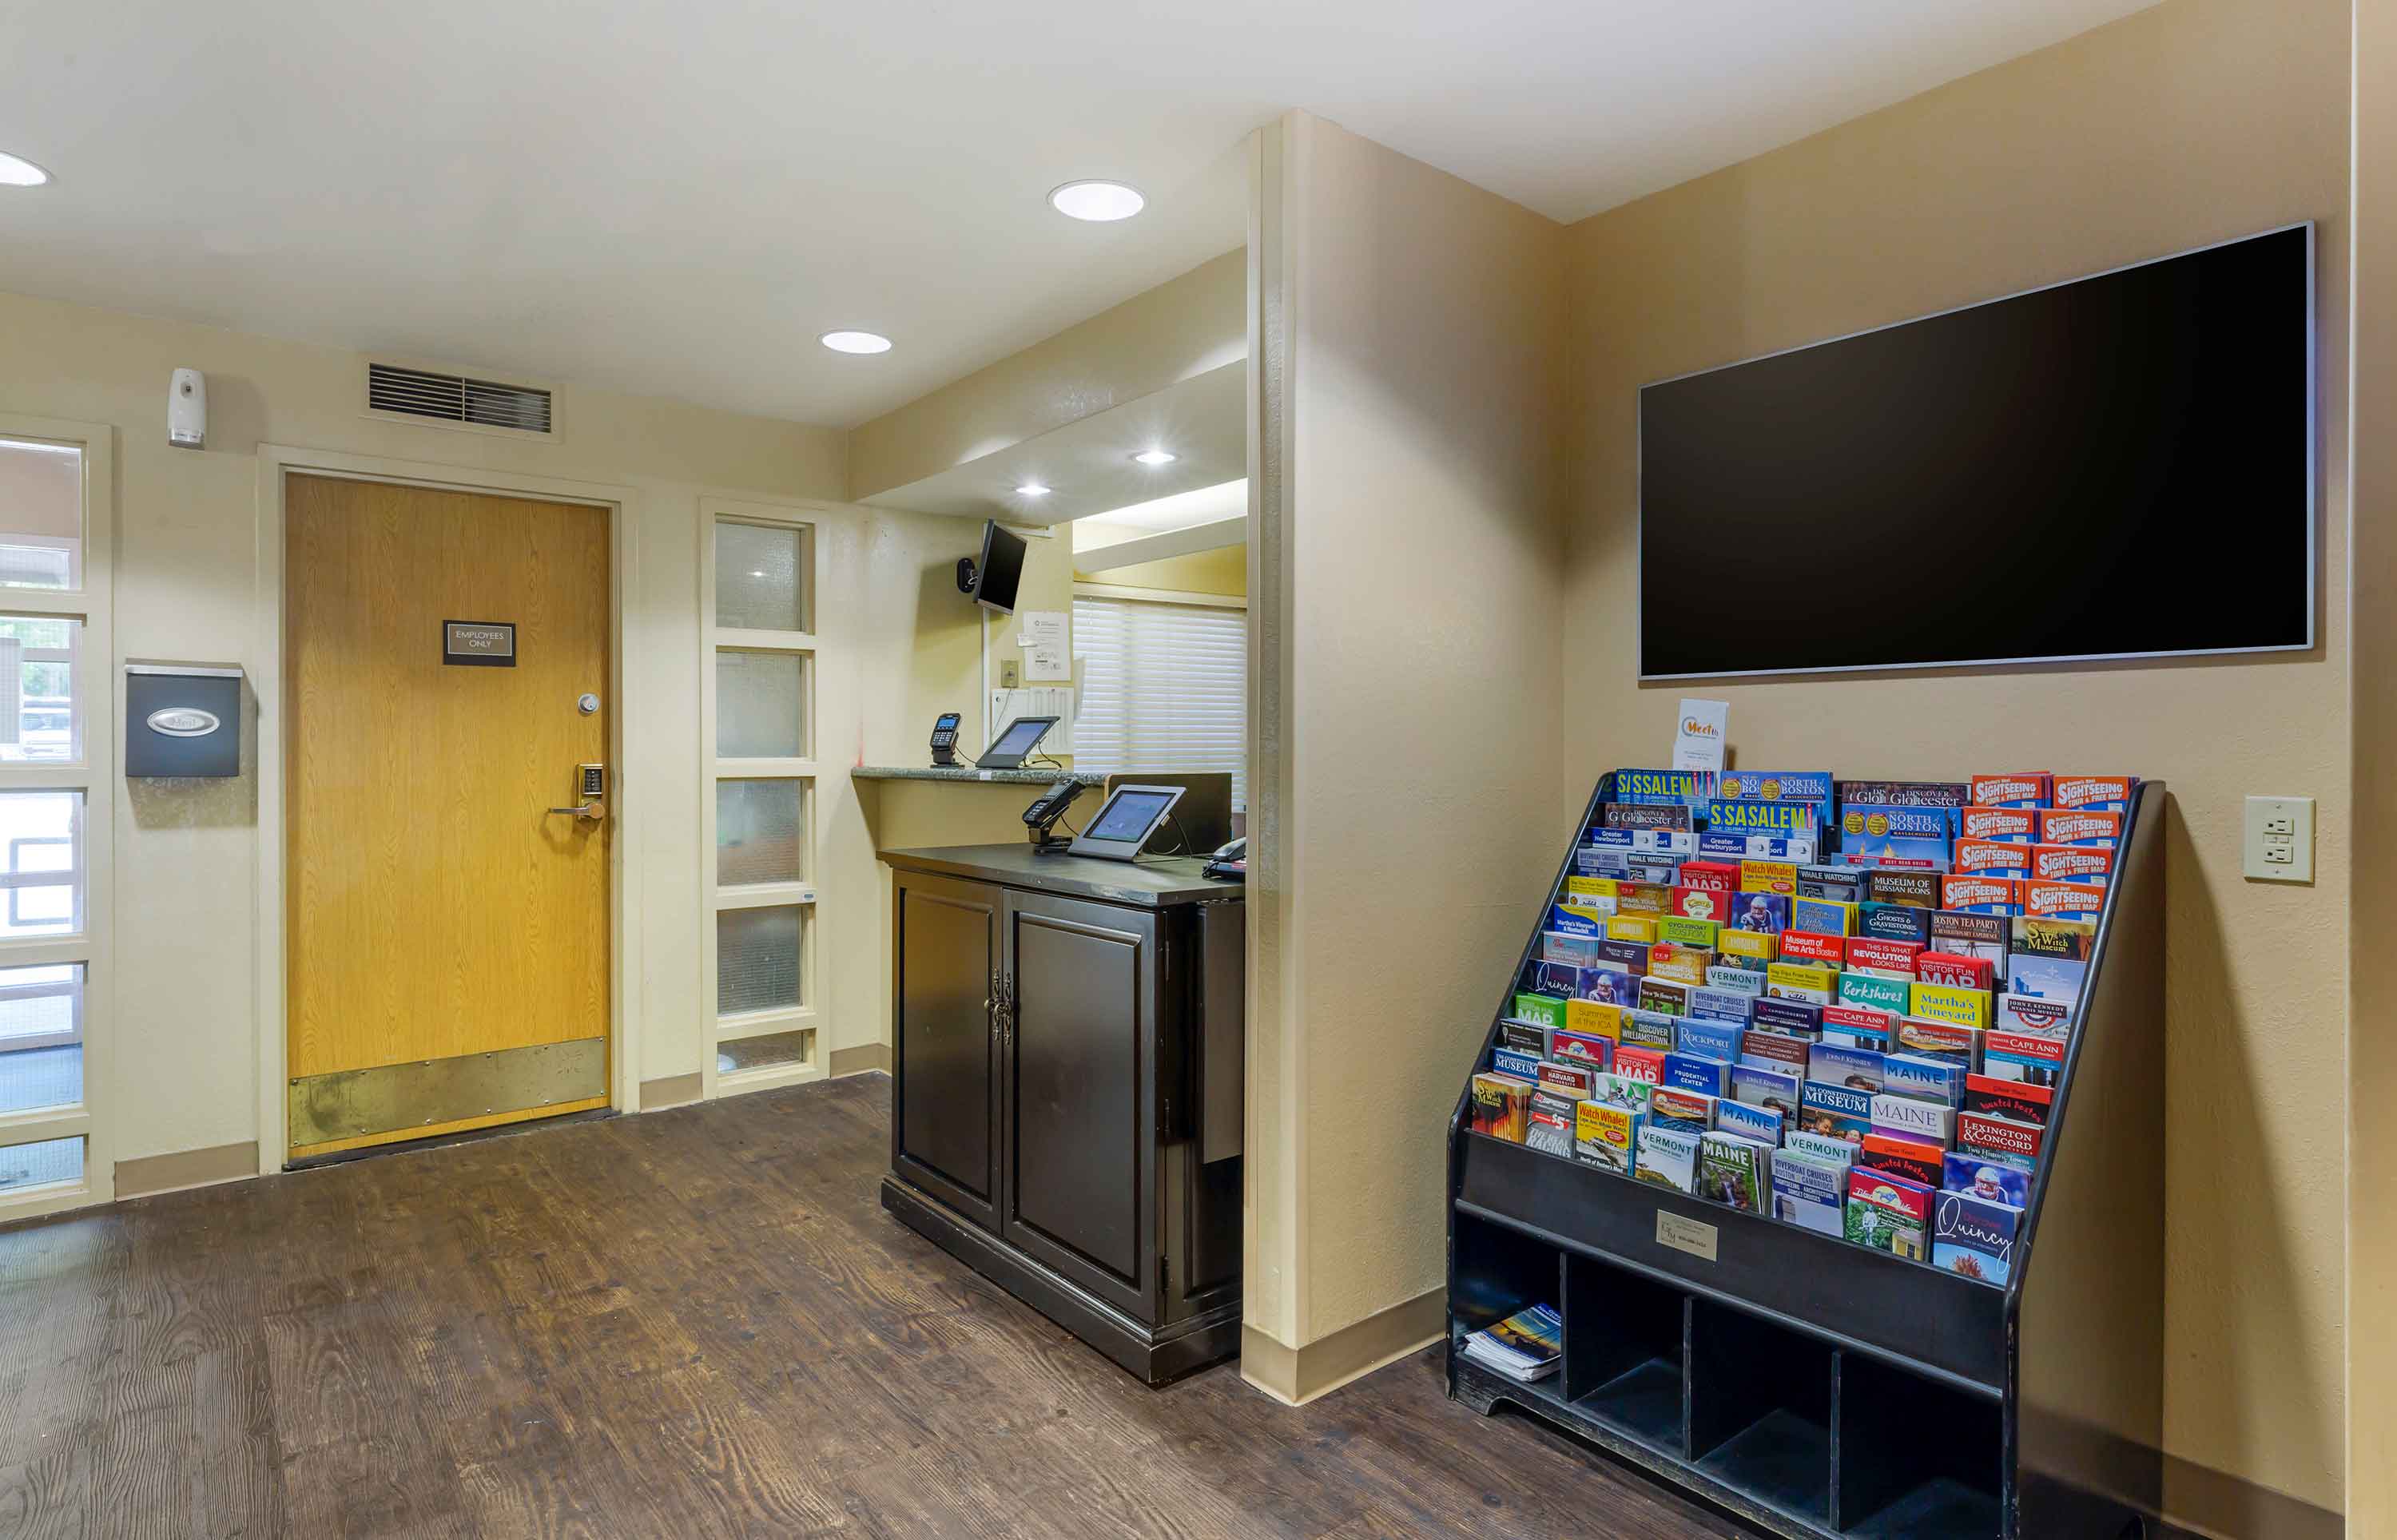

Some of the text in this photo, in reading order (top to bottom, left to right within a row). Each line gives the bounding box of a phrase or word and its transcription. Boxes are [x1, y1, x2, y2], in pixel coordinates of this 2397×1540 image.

[455, 631, 504, 640] EMPLOYEES
[1782, 786, 1825, 795] BOSTON
[1975, 782, 2037, 803] SIGHTSEEING
[2057, 783, 2123, 804] SIGHTSEEING
[1890, 793, 1959, 807] Gloucester
[1622, 812, 1672, 824] Gloucester
[1748, 806, 1806, 830] SALEM
[1889, 815, 1932, 824] NORTH
[1967, 815, 2028, 835] SIGHTSEEING
[1889, 823, 1941, 832] BOSTON
[2046, 818, 2113, 840] SIGHTSEEING
[1702, 843, 1743, 852] Newburyport
[1628, 854, 1674, 864] WHALE WATCHING
[1962, 845, 2025, 867] SIGHTSEEING
[1744, 863, 1795, 876] Watch Whales!
[2039, 853, 2106, 876] SIGHTSEEING
[1801, 871, 1857, 883] WHALE WATCHING
[1874, 877, 1915, 887] MUSEUM
[1945, 883, 2008, 904] SIGHTSEEING
[2030, 888, 2099, 910] SIGHTSEEING
[1869, 919, 1918, 931] GRAVESTONES
[1877, 913, 1903, 923] GHOSTS
[1934, 915, 1958, 925] BOSTON
[1960, 918, 1971, 927] TEA
[1973, 919, 2000, 930] PARTY
[1668, 921, 1707, 931] CYCLEBOAT
[1668, 928, 1707, 939] BOSTON
[1785, 935, 1815, 946] Museum
[2028, 939, 2067, 953] Museum
[2041, 932, 2069, 947] Witch
[1785, 944, 1838, 957] Fine Arts Boston
[1854, 949, 1911, 963] REVOLUTION
[1871, 959, 1894, 967] LOOKS
[1896, 962, 1911, 970] LIKE
[1920, 964, 1975, 977] VISITOR FUN
[1535, 963, 1576, 998] Quincy
[1711, 971, 1758, 985] VERMONT
[1920, 971, 1975, 988] MAP
[1695, 991, 1723, 1003] RIVERBOAT
[1724, 996, 1745, 1006] CRUISES
[1844, 981, 1903, 1002] Berkshires
[1921, 993, 1974, 1009] Martha's
[2033, 1003, 2065, 1012] KENNEDY
[1518, 1009, 1552, 1024] MAP
[1578, 1009, 1611, 1020] Summer
[1844, 1011, 1865, 1022] CAPE
[1866, 1016, 1885, 1025] ANN
[1920, 1005, 1976, 1022] Vineyard
[1584, 1018, 1596, 1027] the
[1639, 1023, 1668, 1037] DISCOVER
[1622, 1028, 1668, 1046] WILLIAMSTOWN
[1680, 1027, 1731, 1048] ROCKPORT
[2009, 1038, 2034, 1049] CAPE
[2037, 1043, 2058, 1054] ANN
[1496, 1058, 1537, 1074] MUSEUM
[1616, 1058, 1657, 1071] VISITOR FUN
[1548, 1071, 1576, 1083] HARVARD
[1616, 1064, 1657, 1083] MAP
[1675, 1069, 1709, 1083] PRUDENTIAL
[1886, 1064, 1943, 1086] MAINE
[1680, 1077, 1703, 1087] CENTER
[1805, 1091, 1867, 1113] MUSEUM
[1819, 1087, 1867, 1102] CONSTITUTION
[1580, 1105, 1628, 1126] Watch Whales!
[1723, 1108, 1771, 1131] MAINE
[1874, 1102, 1937, 1127] MAINE
[1963, 1119, 2033, 1142] LEXINGTON
[1527, 1136, 1571, 1158] RACING
[1643, 1131, 1692, 1155] VERMONT
[1791, 1137, 1848, 1159] VERMONT
[1703, 1141, 1749, 1166] MAINE
[1967, 1145, 1981, 1154] Two
[1982, 1149, 2008, 1161] Historic
[2009, 1156, 2029, 1165] Towns
[1775, 1158, 1834, 1183] RIVERBOAT CRUISES
[1775, 1169, 1834, 1191] BOSTON CAMBRIDGE
[1803, 1186, 1835, 1200] ARCHITECTURE
[1936, 1197, 2013, 1274] Quincy
